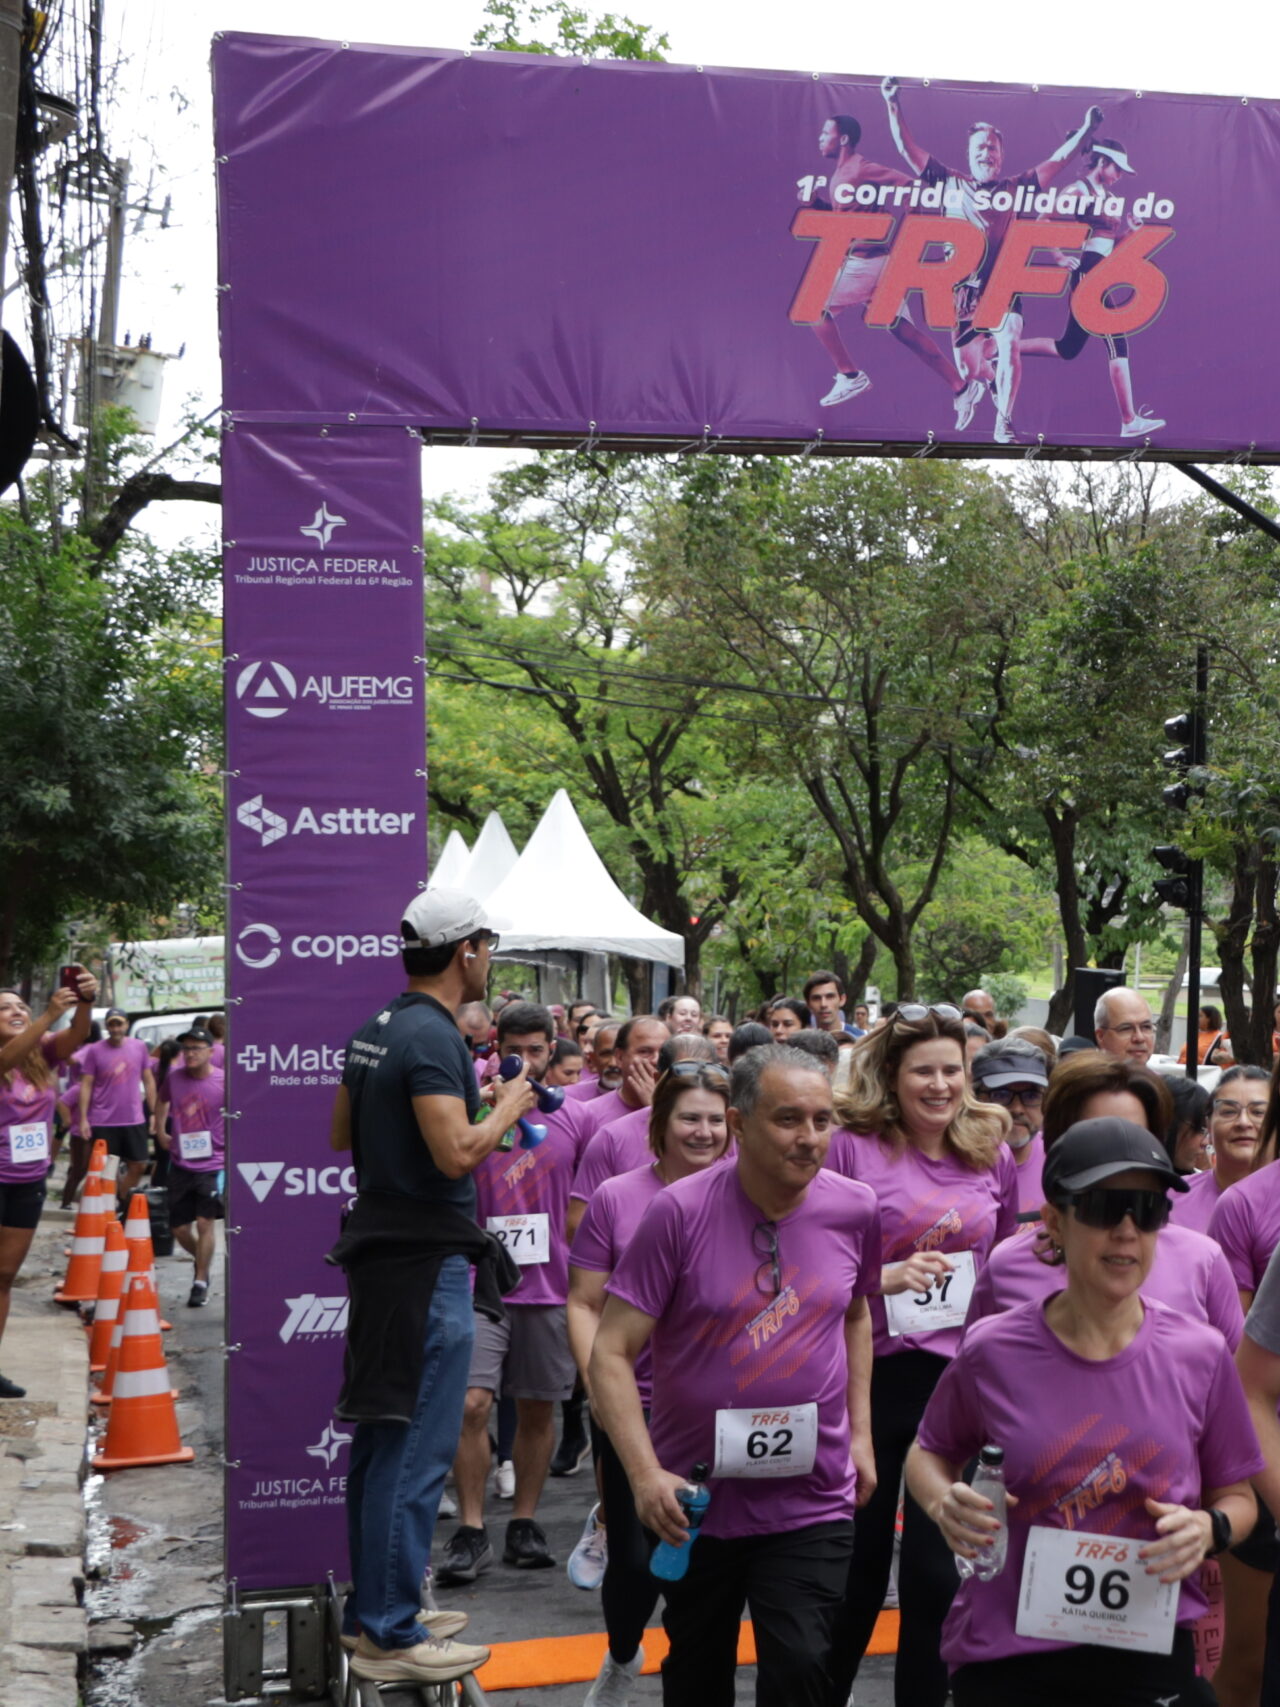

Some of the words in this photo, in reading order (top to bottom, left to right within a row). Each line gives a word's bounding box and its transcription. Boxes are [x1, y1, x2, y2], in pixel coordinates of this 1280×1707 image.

[797, 175, 827, 203] 1ª
[834, 179, 965, 213] corrida
[1132, 192, 1175, 220] do
[787, 208, 1177, 338] TRF6
[247, 557, 319, 575] JUSTIÇA
[324, 558, 401, 574] FEDERAL
[234, 574, 273, 584] Tribunal
[275, 575, 316, 586] Regional
[318, 576, 353, 586] Federal
[354, 577, 367, 586] da
[382, 577, 414, 587] Região
[302, 676, 413, 704] AJUFEMG
[292, 806, 416, 835] Asttter
[291, 934, 407, 965] copas
[270, 1075, 301, 1086] Rede
[303, 1075, 318, 1085] de
[15, 1132, 45, 1150] 283
[496, 1228, 535, 1248] 271
[749, 1289, 800, 1350] TRF6
[751, 1411, 790, 1426] TRF6
[746, 1429, 793, 1459] 62
[251, 1477, 324, 1497] JUSTIÇA
[329, 1476, 348, 1492] FE
[1058, 1458, 1127, 1530] TRF6
[238, 1499, 278, 1510] Tribunal
[280, 1496, 321, 1508] Regional
[322, 1495, 346, 1505] Fede
[1074, 1541, 1131, 1563] TRF6
[1064, 1564, 1131, 1611] 96
[1089, 1610, 1128, 1622] QUEIROZ
